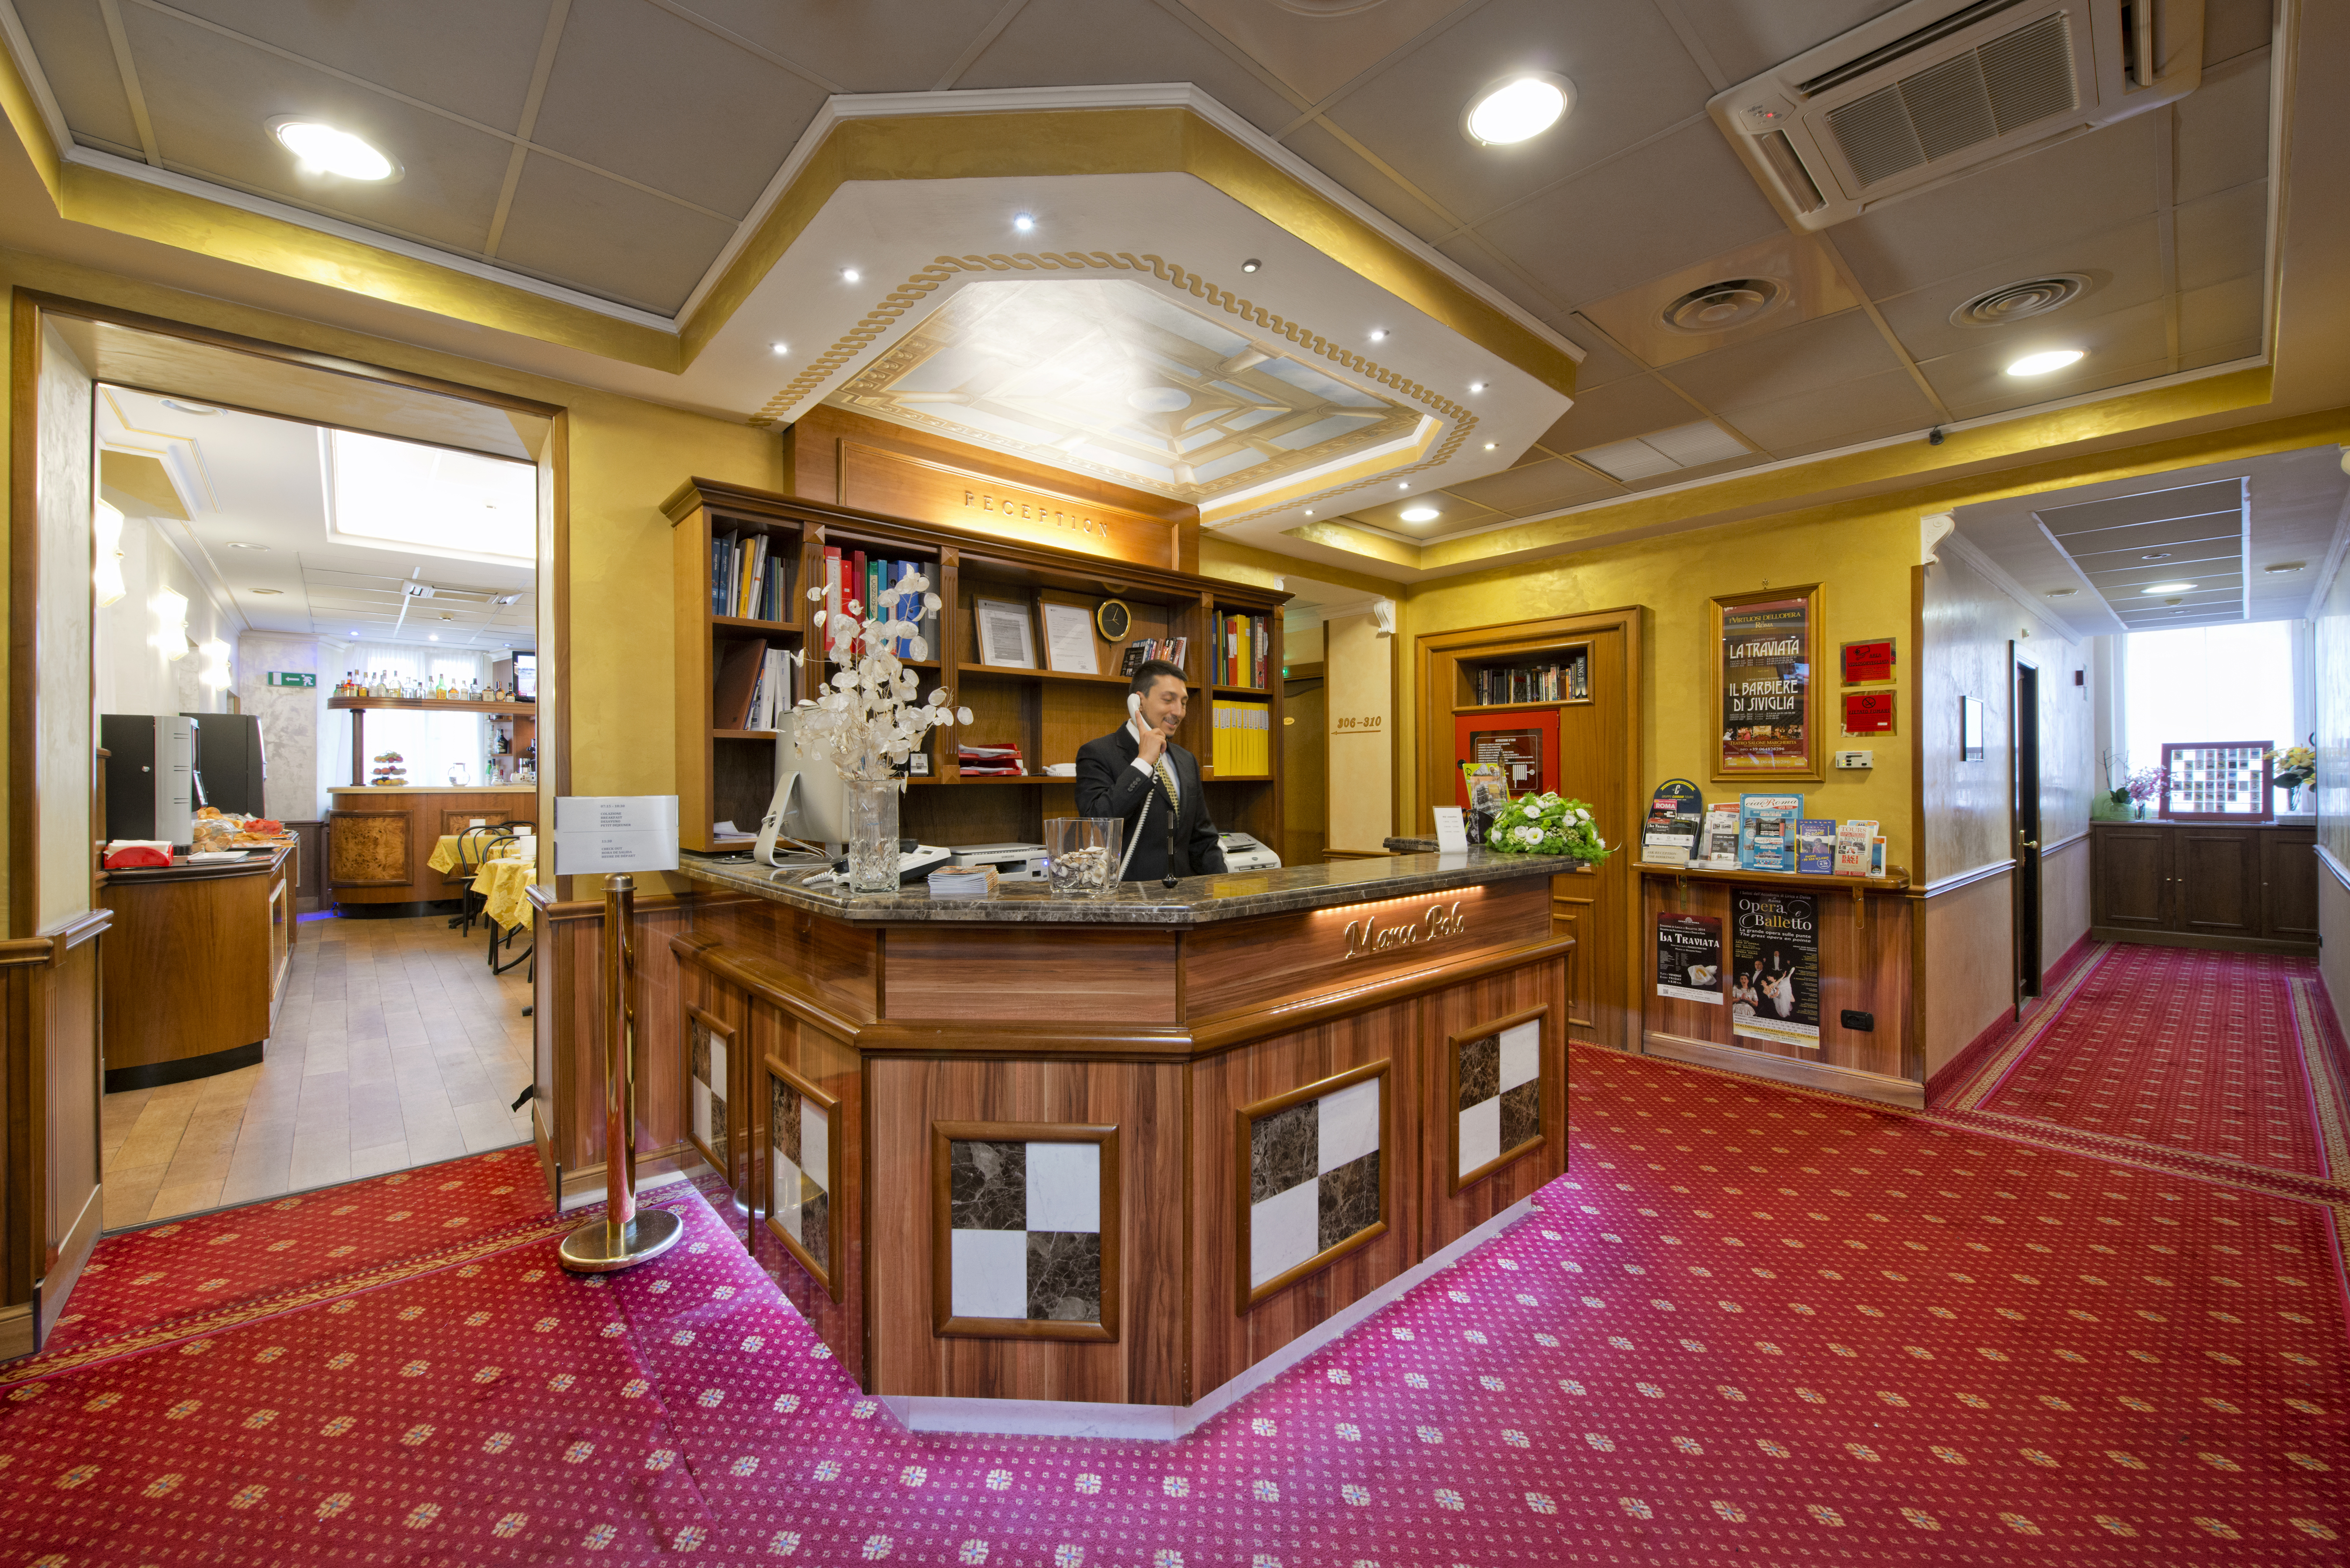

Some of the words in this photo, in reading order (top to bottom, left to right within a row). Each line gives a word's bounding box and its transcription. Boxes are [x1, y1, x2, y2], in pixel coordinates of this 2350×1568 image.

[1748, 105, 1763, 113] FUJITSU
[965, 491, 1107, 537] RECEPTION
[1763, 612, 1800, 620] DELL'OPERA
[1730, 644, 1743, 659] LA
[1745, 640, 1799, 658] TRAVIATA
[1730, 683, 1739, 696] IL
[1742, 680, 1798, 696] BARBIERE
[1733, 698, 1744, 712] DI
[1747, 696, 1794, 711] SIVIGLIA
[1761, 798, 1797, 807] Roma
[1739, 899, 1784, 913] Opera
[1342, 916, 1417, 959] Marco
[1425, 901, 1465, 941] Polo
[1754, 914, 1812, 930] Balletto
[1660, 932, 1672, 942] LA
[1675, 933, 1720, 948] TRAVIATA
